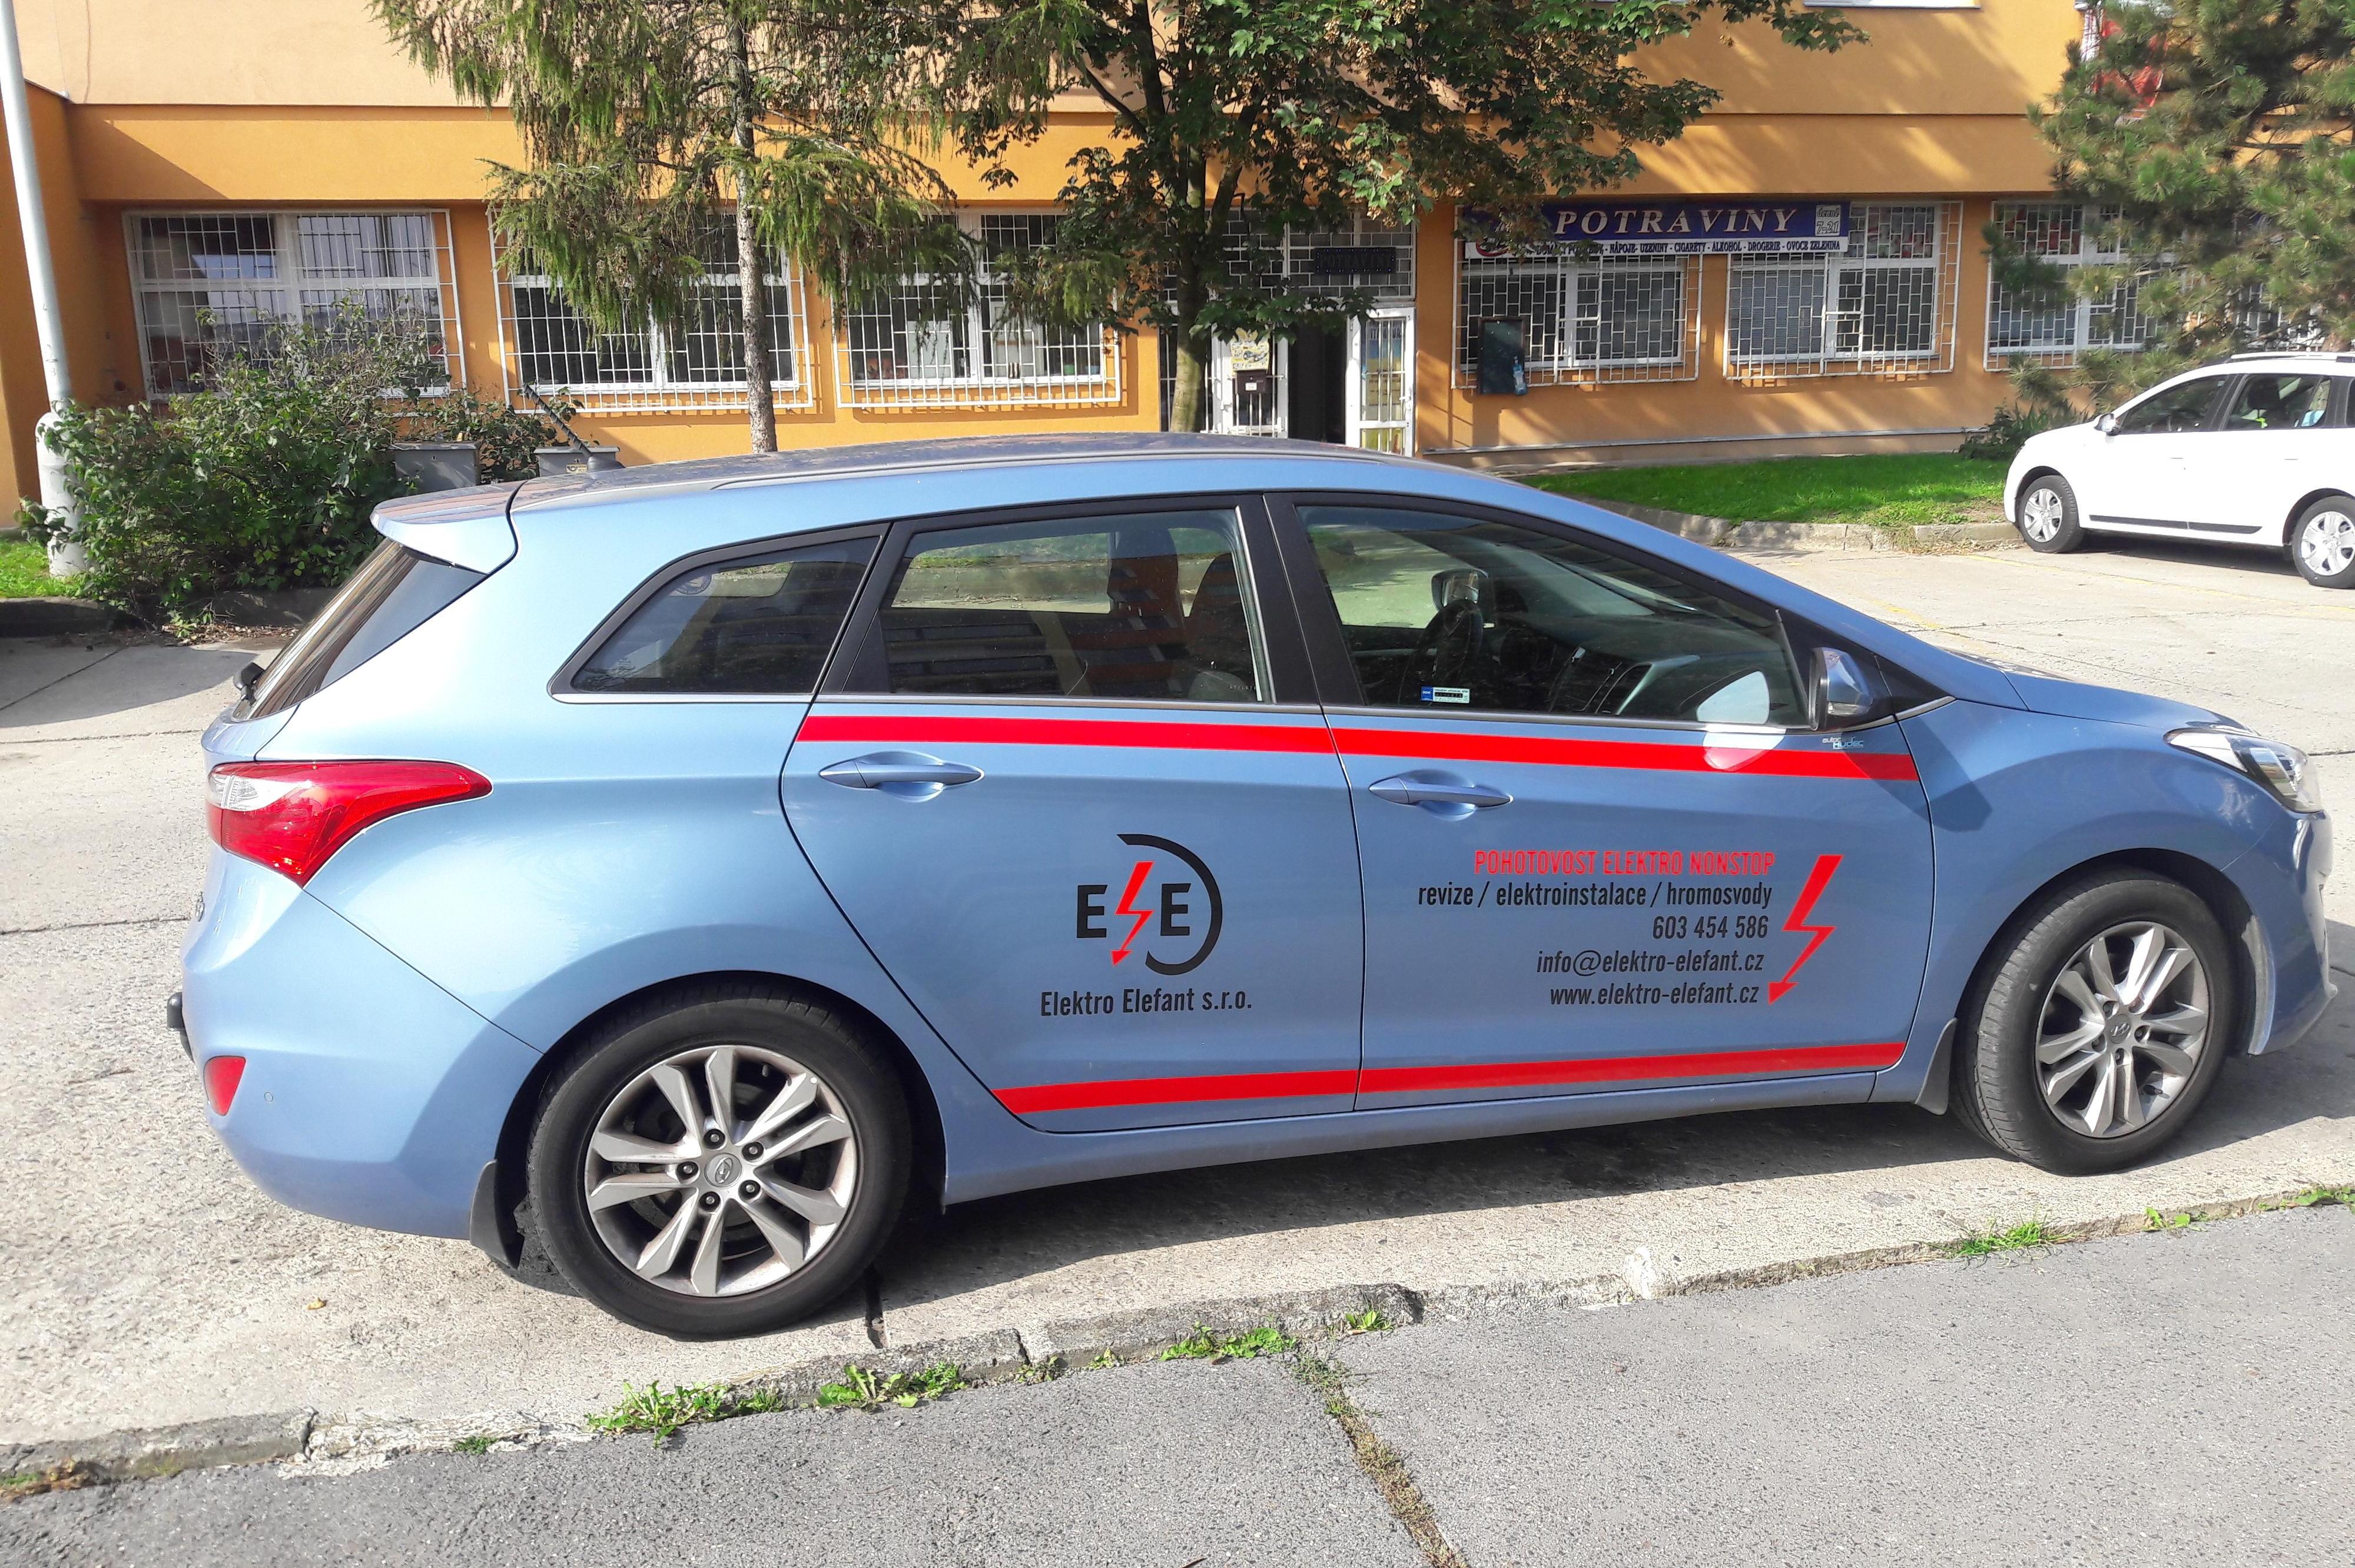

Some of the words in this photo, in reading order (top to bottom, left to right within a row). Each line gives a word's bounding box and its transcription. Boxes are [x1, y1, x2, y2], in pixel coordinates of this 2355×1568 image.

[1554, 208, 1797, 235] POTRAVINY
[1640, 242, 1669, 253] UZENINY
[1747, 241, 1781, 251] DROGERIE
[1786, 241, 1809, 251] OVOCE
[1810, 240, 1840, 251] ZELENINA
[1474, 849, 1597, 875] POHOTOVOST
[1603, 850, 1683, 875] ELEKTRO
[1689, 851, 1776, 876] NONSTOP
[1418, 881, 1474, 905] revize
[1496, 882, 1647, 906] elektroinstalace
[1666, 882, 1773, 909] hromosvody
[1652, 915, 1687, 939] 603
[1693, 916, 1728, 939] 454
[1734, 915, 1769, 939] 586
[1536, 949, 1765, 976] info@elektro-elefant.cz
[1040, 991, 1114, 1016] Elektro
[1122, 988, 1195, 1013] Elefant
[1201, 991, 1252, 1011] s.r.o.
[1550, 982, 1760, 1005] www.elektro-elefant.cz
